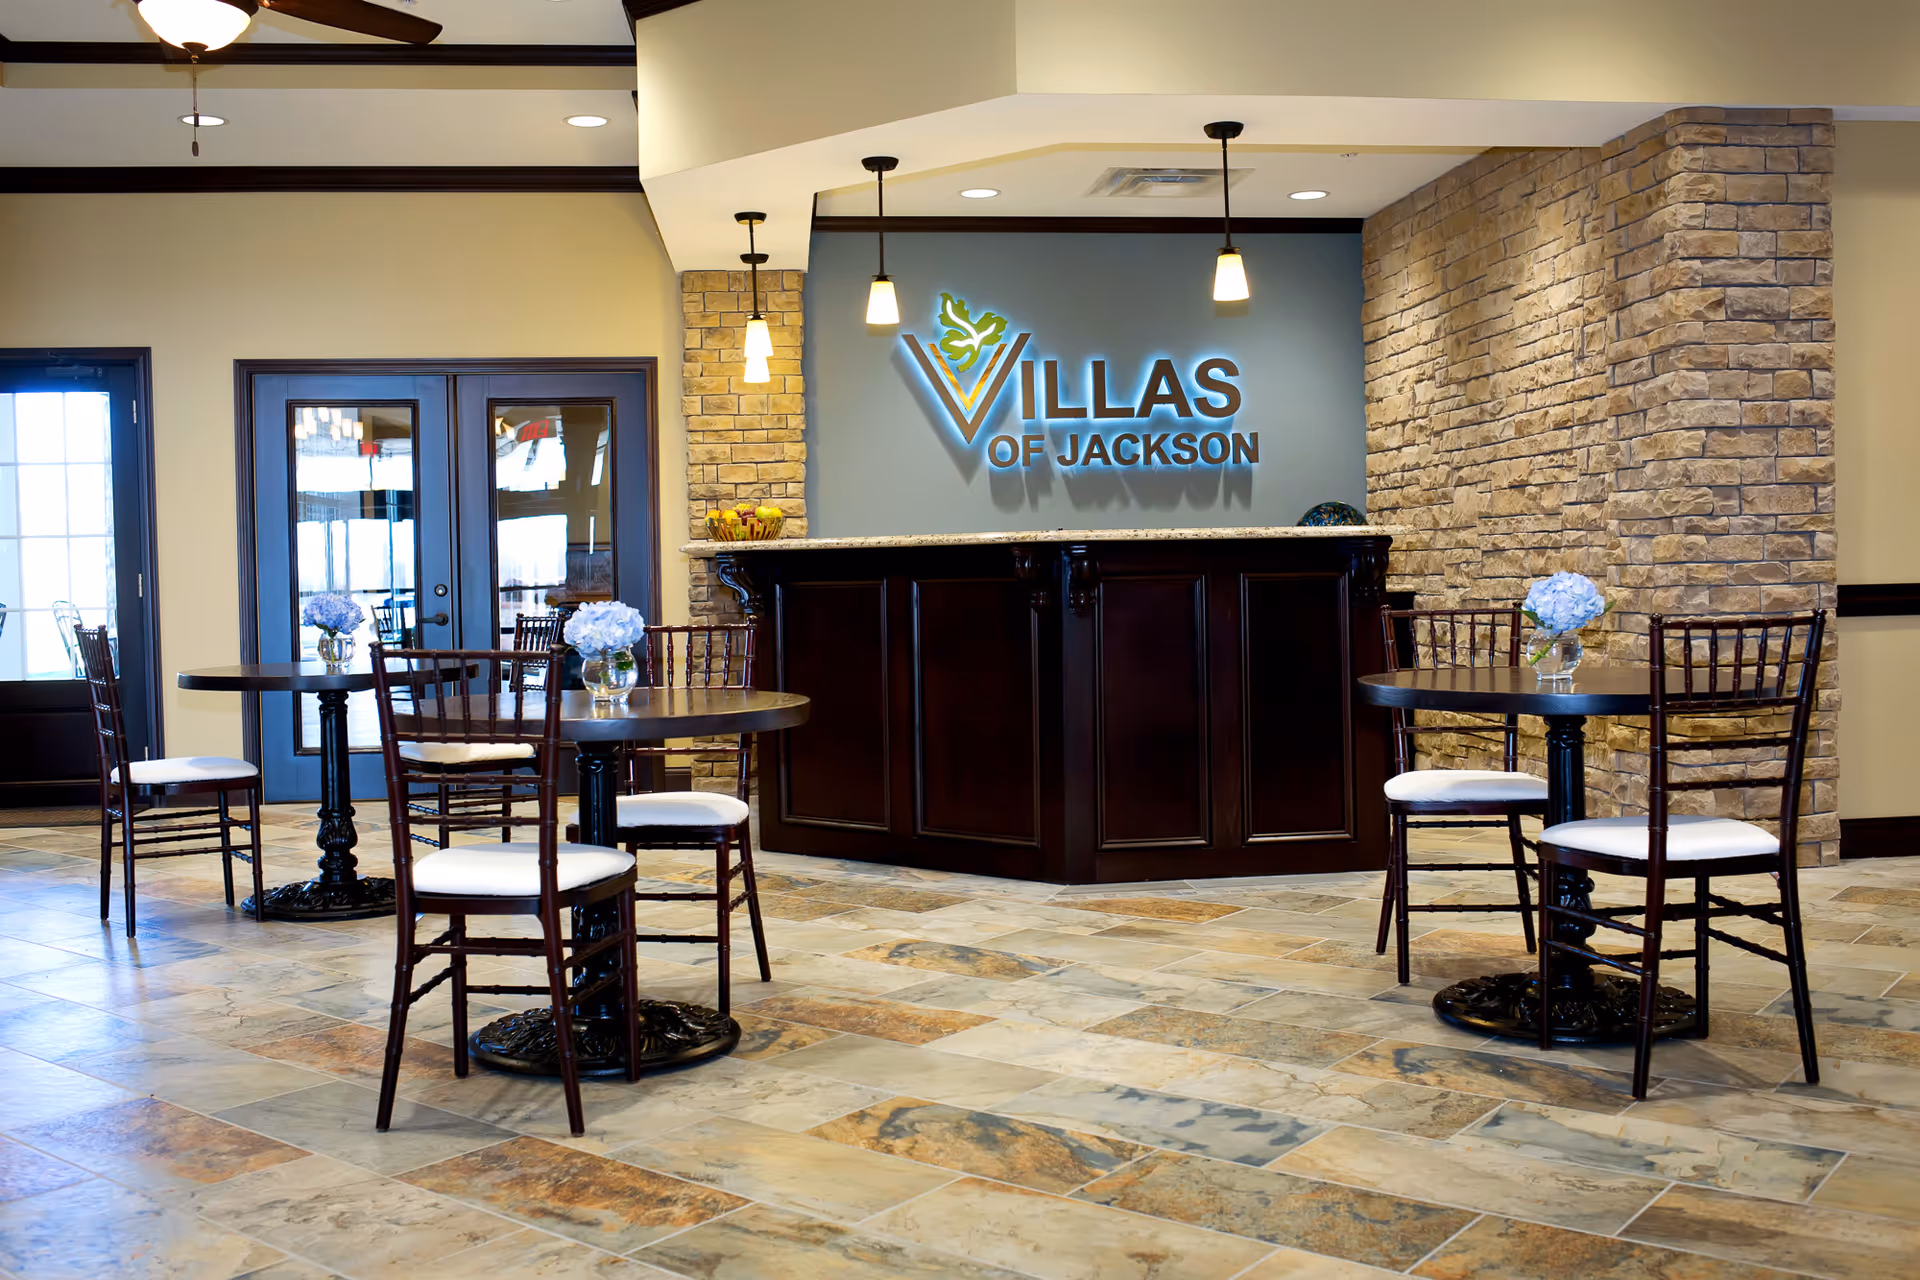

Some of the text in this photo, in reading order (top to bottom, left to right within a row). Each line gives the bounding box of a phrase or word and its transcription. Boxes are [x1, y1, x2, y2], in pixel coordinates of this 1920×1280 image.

[902, 333, 1242, 444] VILLAS
[988, 431, 1260, 468] OF JACKSON
